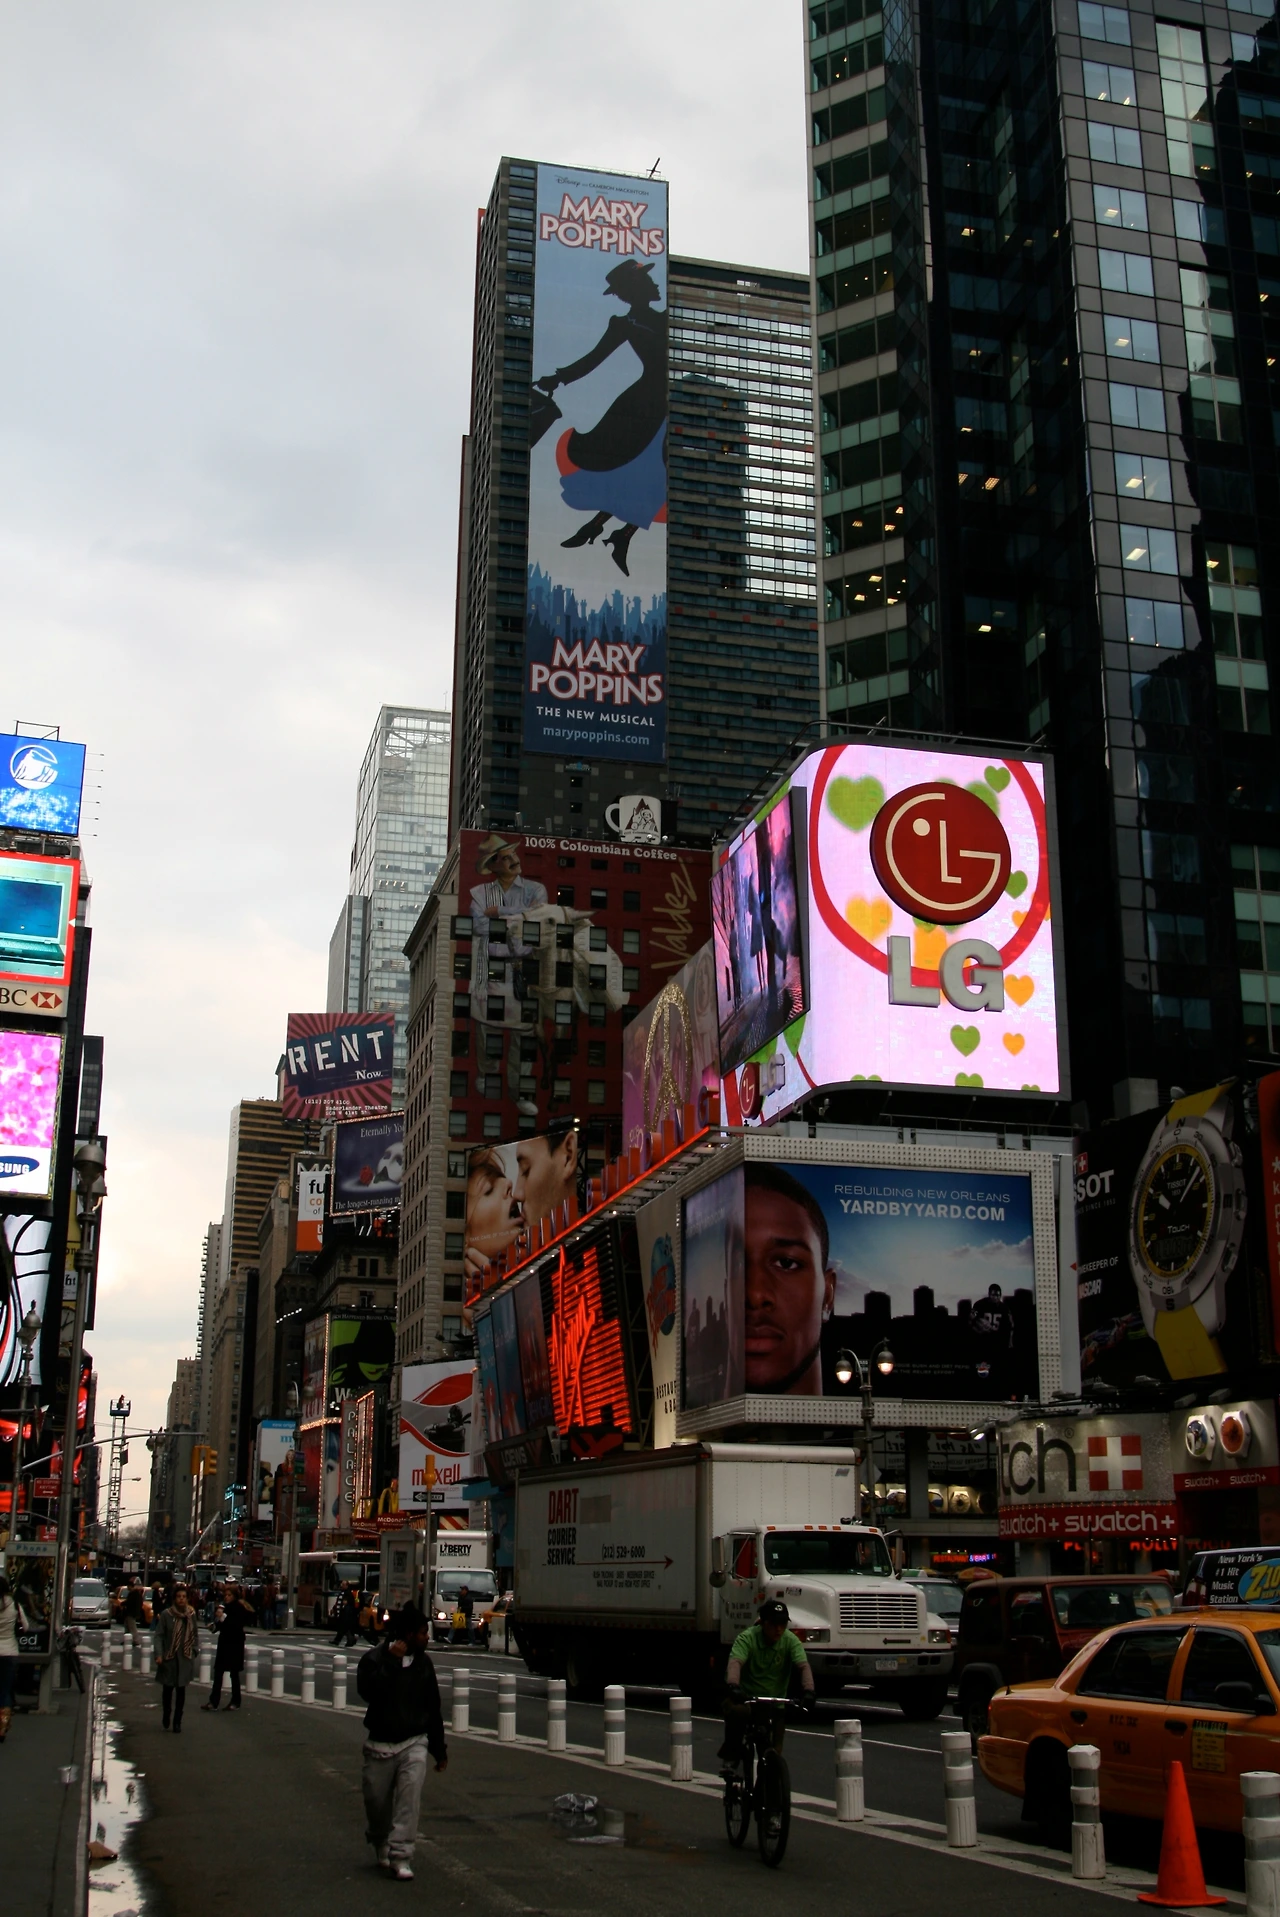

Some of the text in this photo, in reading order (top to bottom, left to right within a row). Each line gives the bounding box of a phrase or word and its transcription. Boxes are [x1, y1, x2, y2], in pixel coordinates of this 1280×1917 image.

[560, 193, 648, 229] MARY
[540, 213, 665, 257] POPPINS
[552, 637, 645, 674] MARY
[530, 662, 664, 706] POPPINS
[536, 706, 655, 727] THE NEW MUSICAL
[543, 726, 650, 745] marypoppins.com
[525, 836, 677, 860] 100% Colombian Coffee
[887, 935, 1005, 1012] LG
[287, 1030, 384, 1076] RENT
[360, 1124, 391, 1138] Eternally
[834, 1184, 1010, 1203] REBUILDING NEW ORLEANS
[839, 1199, 1005, 1222] YARDBYYARD.COM
[344, 1410, 356, 1504] PALACE
[501, 1446, 528, 1467] LOEWS
[412, 1463, 461, 1486] mxell
[548, 1488, 579, 1525] DART
[1000, 1510, 1158, 1535] swatch swatch
[547, 1527, 577, 1546] COURIER
[547, 1547, 576, 1566] SERVICE
[602, 1543, 615, 1560] (212)
[1218, 1553, 1263, 1564] New York's
[1226, 1566, 1240, 1576] Hit
[1211, 1581, 1235, 1591] Music
[1209, 1594, 1239, 1604] Station
